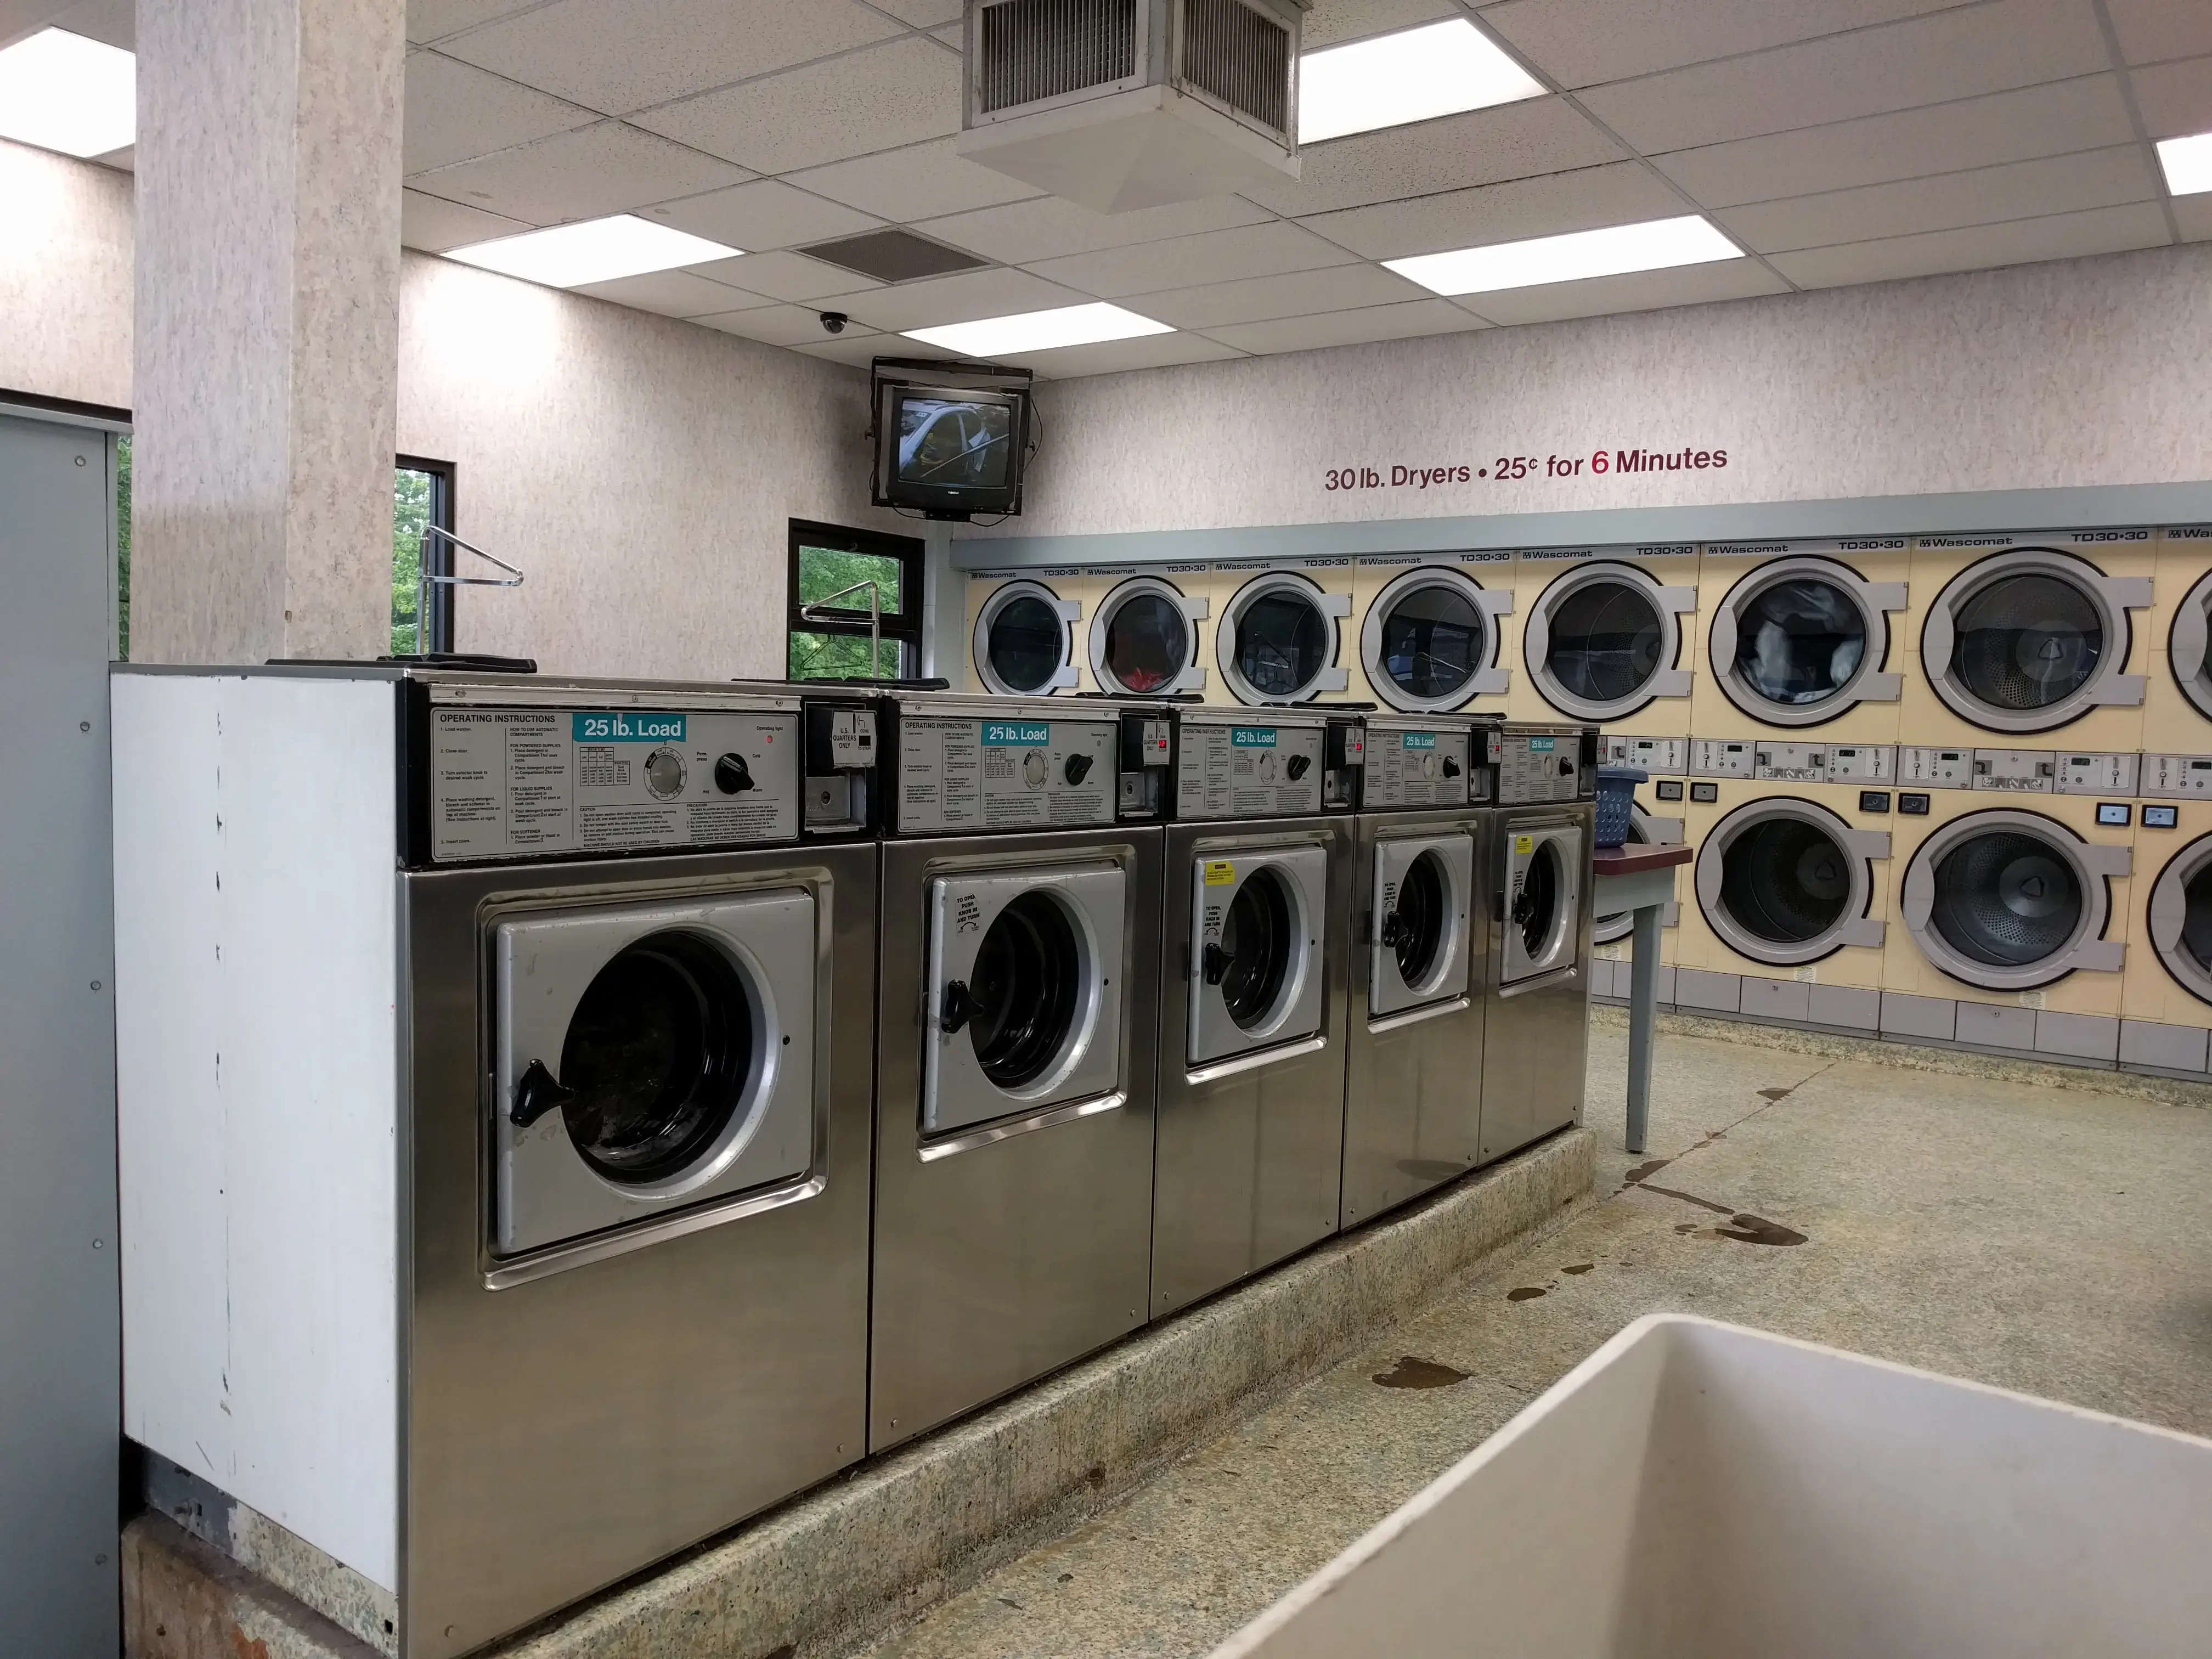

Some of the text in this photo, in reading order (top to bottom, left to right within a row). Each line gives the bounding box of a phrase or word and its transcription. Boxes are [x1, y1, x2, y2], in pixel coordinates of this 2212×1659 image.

[1325, 449, 1728, 491] 30 lb. Dryers 25¢ for 6 Minutes
[1933, 538, 2012, 547] Wascomat
[1719, 545, 1788, 554] Wascomat
[441, 714, 556, 723] OPERATING INSTRUCTIONS
[584, 719, 681, 736] 25 lb. Load
[989, 726, 1047, 741] 25 lb. Load
[1236, 731, 1275, 743] 25 lb. Load
[1406, 736, 1414, 746] 25
[1421, 737, 1435, 746] Load
[1543, 740, 1554, 748] Load
